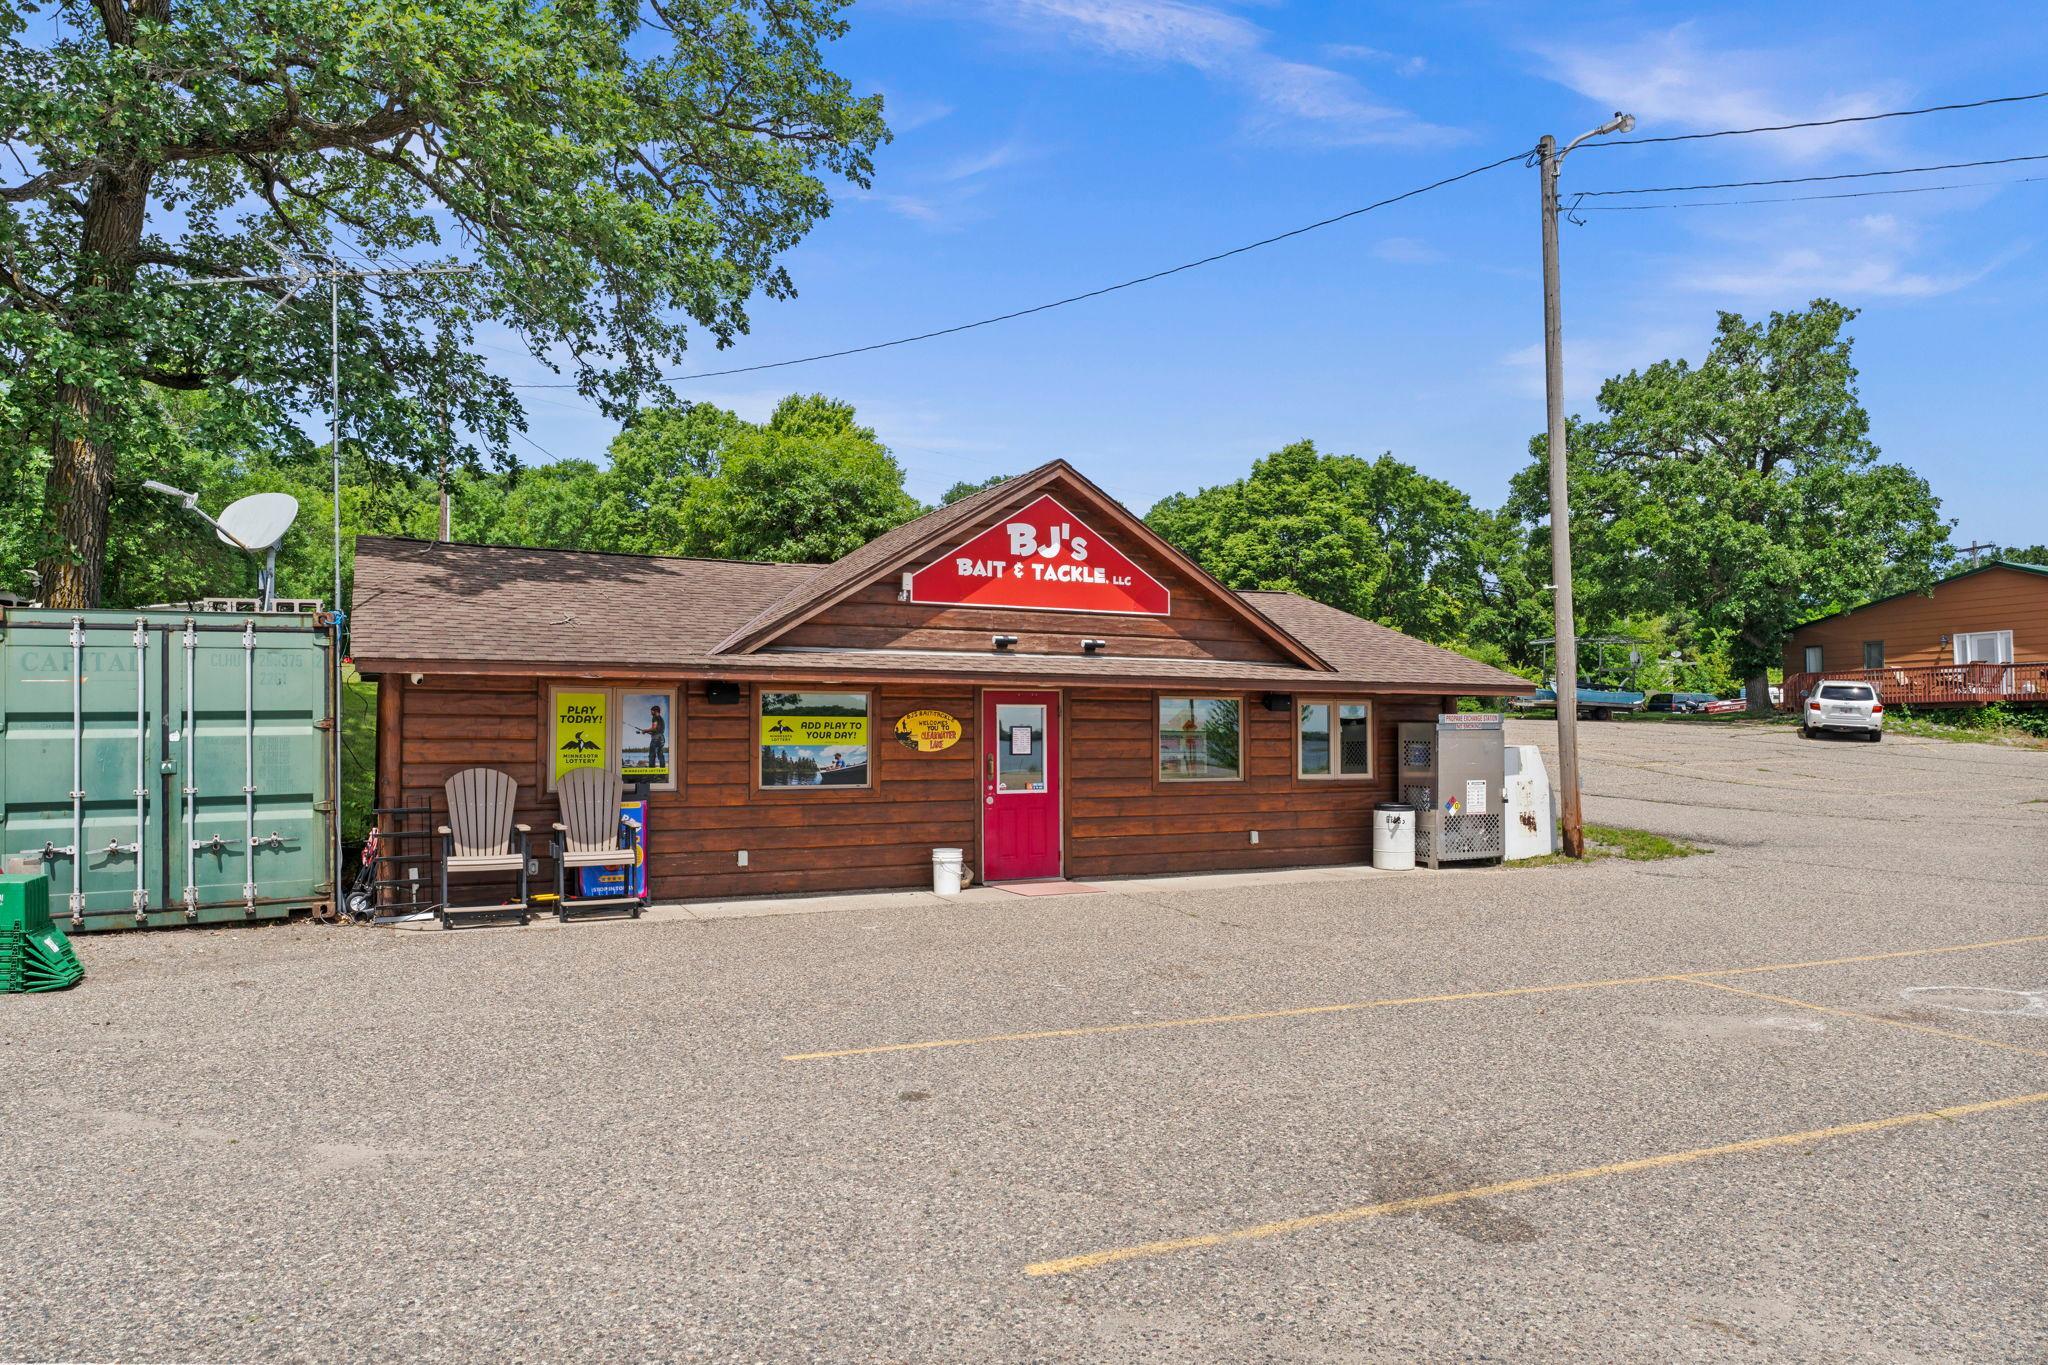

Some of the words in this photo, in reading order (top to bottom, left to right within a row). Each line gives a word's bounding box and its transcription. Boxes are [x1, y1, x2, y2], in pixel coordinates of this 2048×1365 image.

[1006, 522, 1088, 560] BJ's
[956, 558, 1006, 578] BAIT
[1013, 562, 1024, 579] &
[1112, 575, 1132, 586] LLC
[567, 705, 597, 715] PLAY
[559, 715, 603, 724] TODAY!
[800, 721, 821, 730] ADD
[823, 721, 848, 730] PLAY
[849, 721, 862, 730] TO
[806, 731, 831, 740] YOUR
[834, 731, 857, 740] DAY!
[920, 730, 957, 740] CLEARWATER
